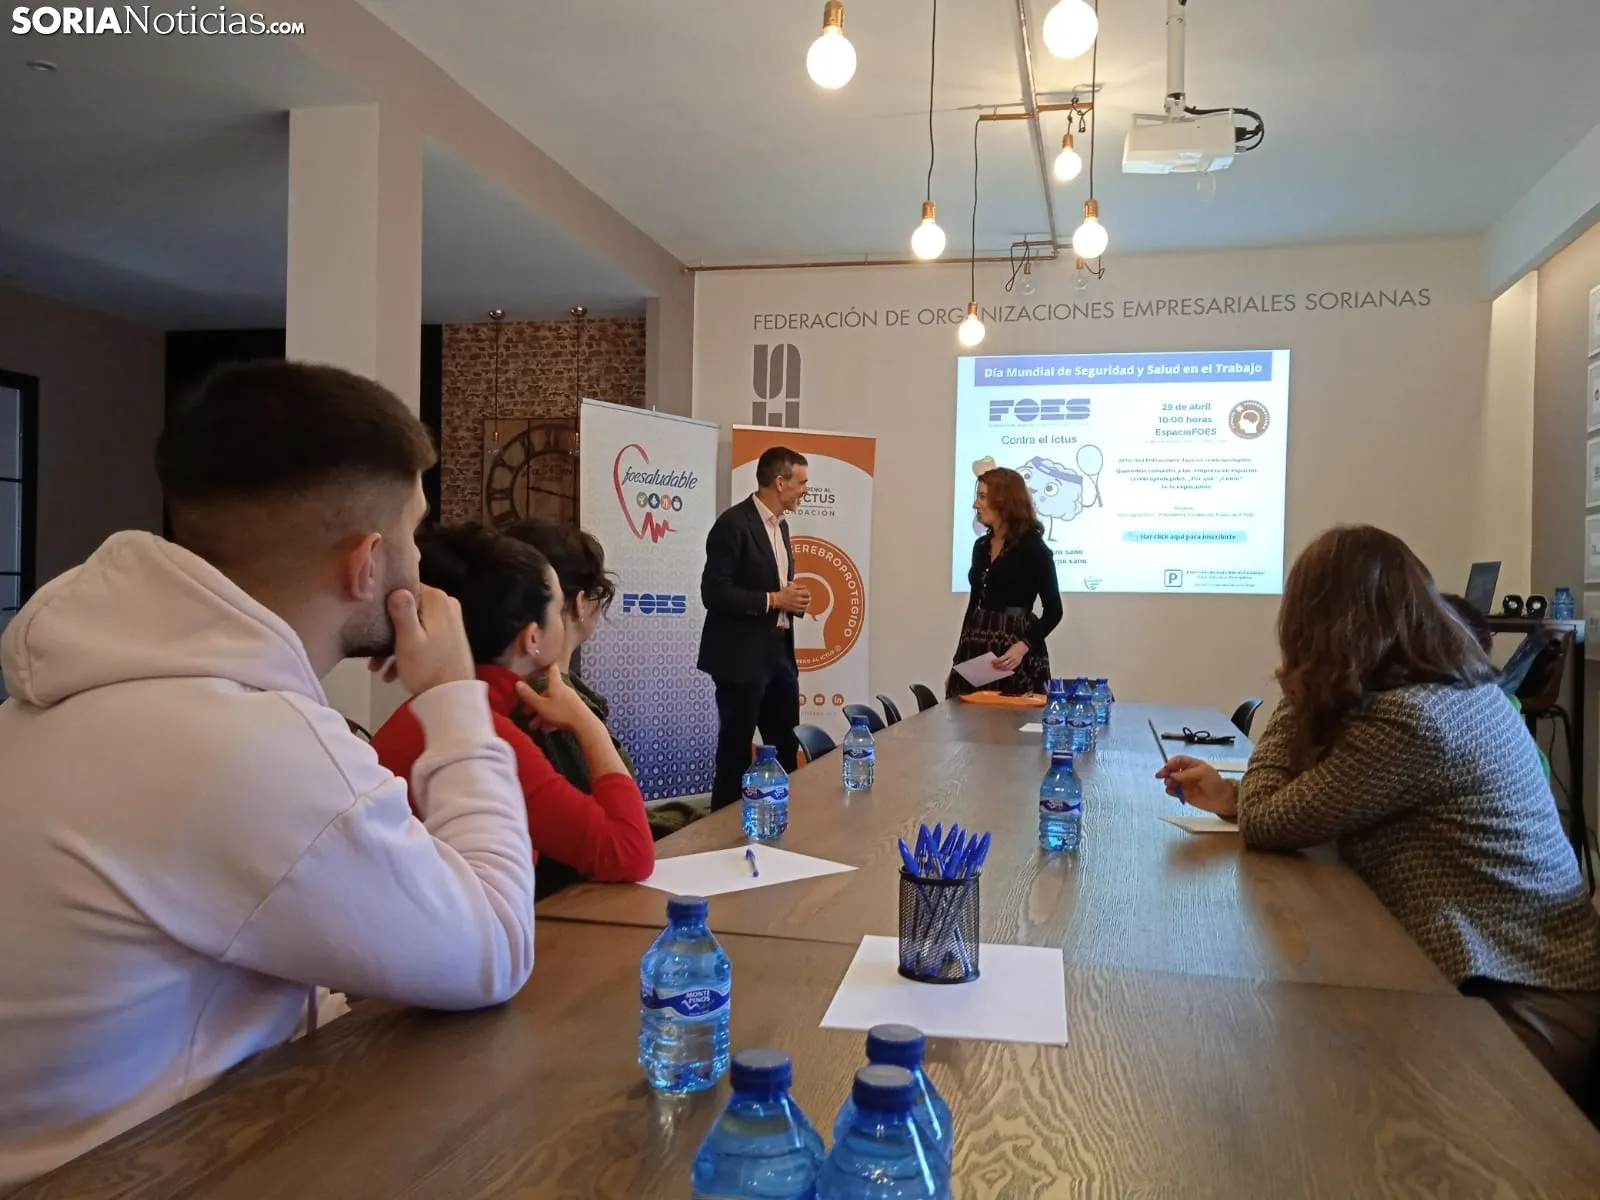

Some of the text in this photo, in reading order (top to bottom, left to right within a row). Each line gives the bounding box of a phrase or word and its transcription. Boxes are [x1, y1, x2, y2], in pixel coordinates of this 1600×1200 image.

[753, 288, 1432, 330] FEDERACIÓN DE ORGNIZACIONES EMPRESARIALES SORIANAS
[984, 362, 1263, 378] Día Mundial de Seguridad y Salud en el Trabajo
[988, 398, 1091, 422] FOES
[1162, 402, 1211, 411] 29 de abril
[1158, 415, 1212, 424] 10:00 horas
[1155, 427, 1217, 437] EspacioFOES
[1001, 435, 1036, 445] Contra
[1038, 435, 1048, 444] el
[621, 466, 698, 490] foesaludable
[802, 493, 836, 504] CTUS
[784, 508, 835, 517] UNDACIÓN
[1168, 572, 1178, 584] P
[791, 543, 860, 638] EREBROPROTEGIDO
[622, 593, 687, 615] FOES
